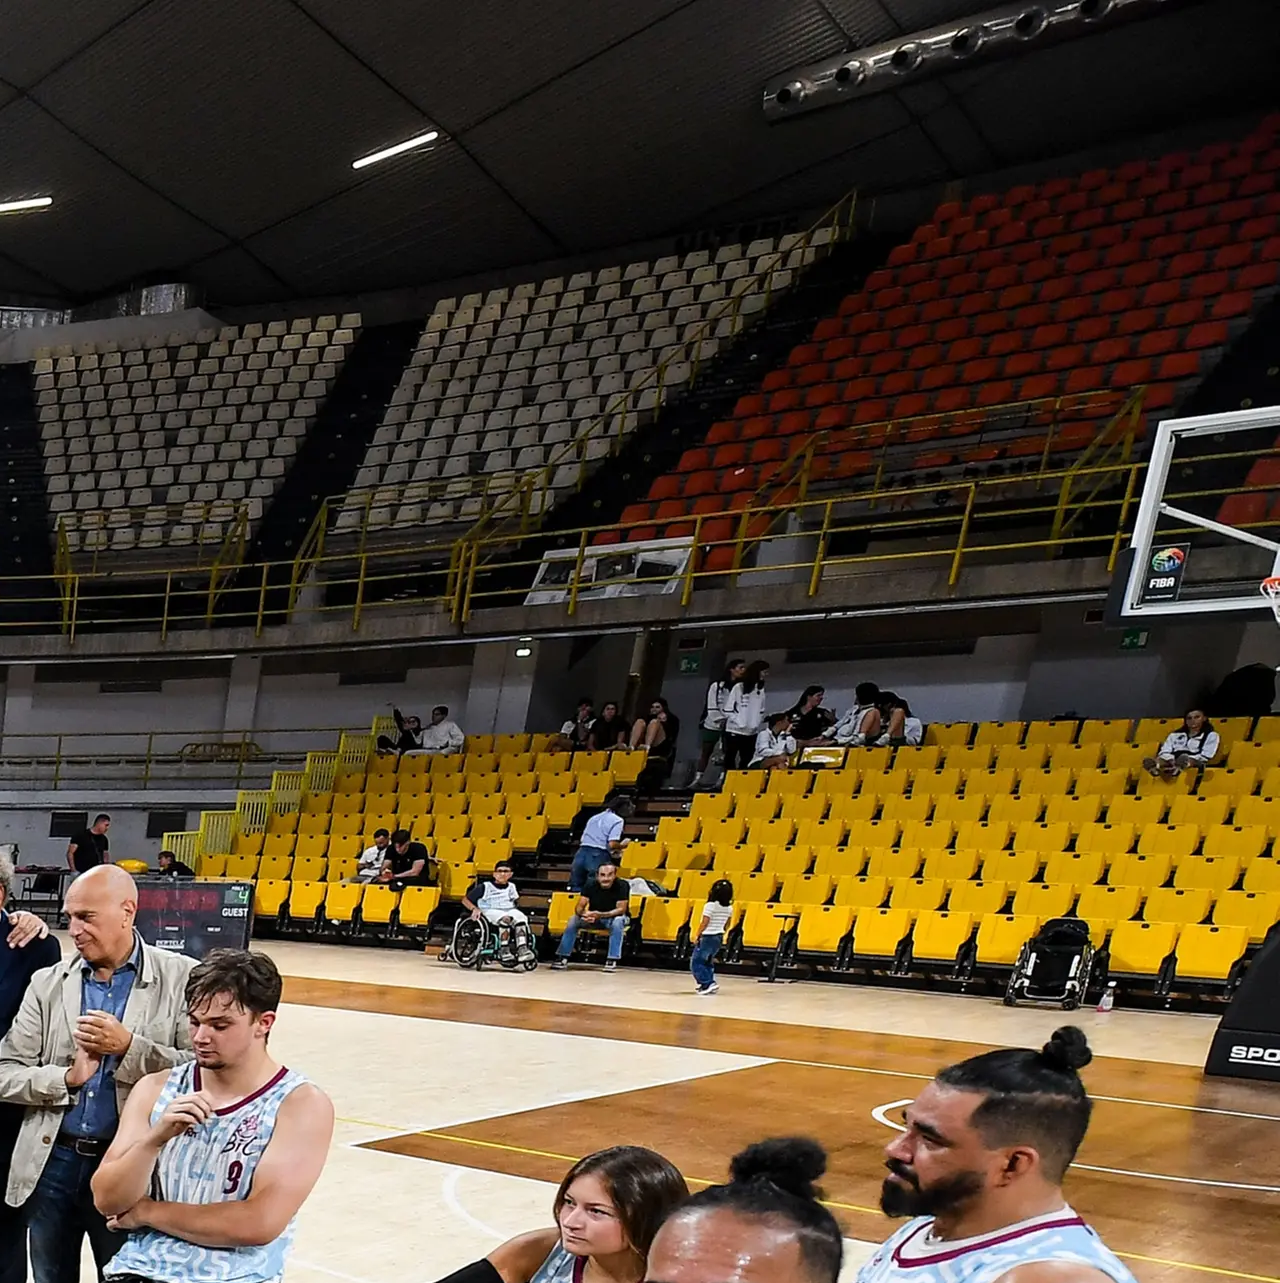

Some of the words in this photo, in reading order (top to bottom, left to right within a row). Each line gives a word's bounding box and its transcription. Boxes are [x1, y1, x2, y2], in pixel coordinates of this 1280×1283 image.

[1149, 577, 1175, 589] FIBA
[221, 906, 250, 918] GUEST
[223, 1160, 244, 1196] 9
